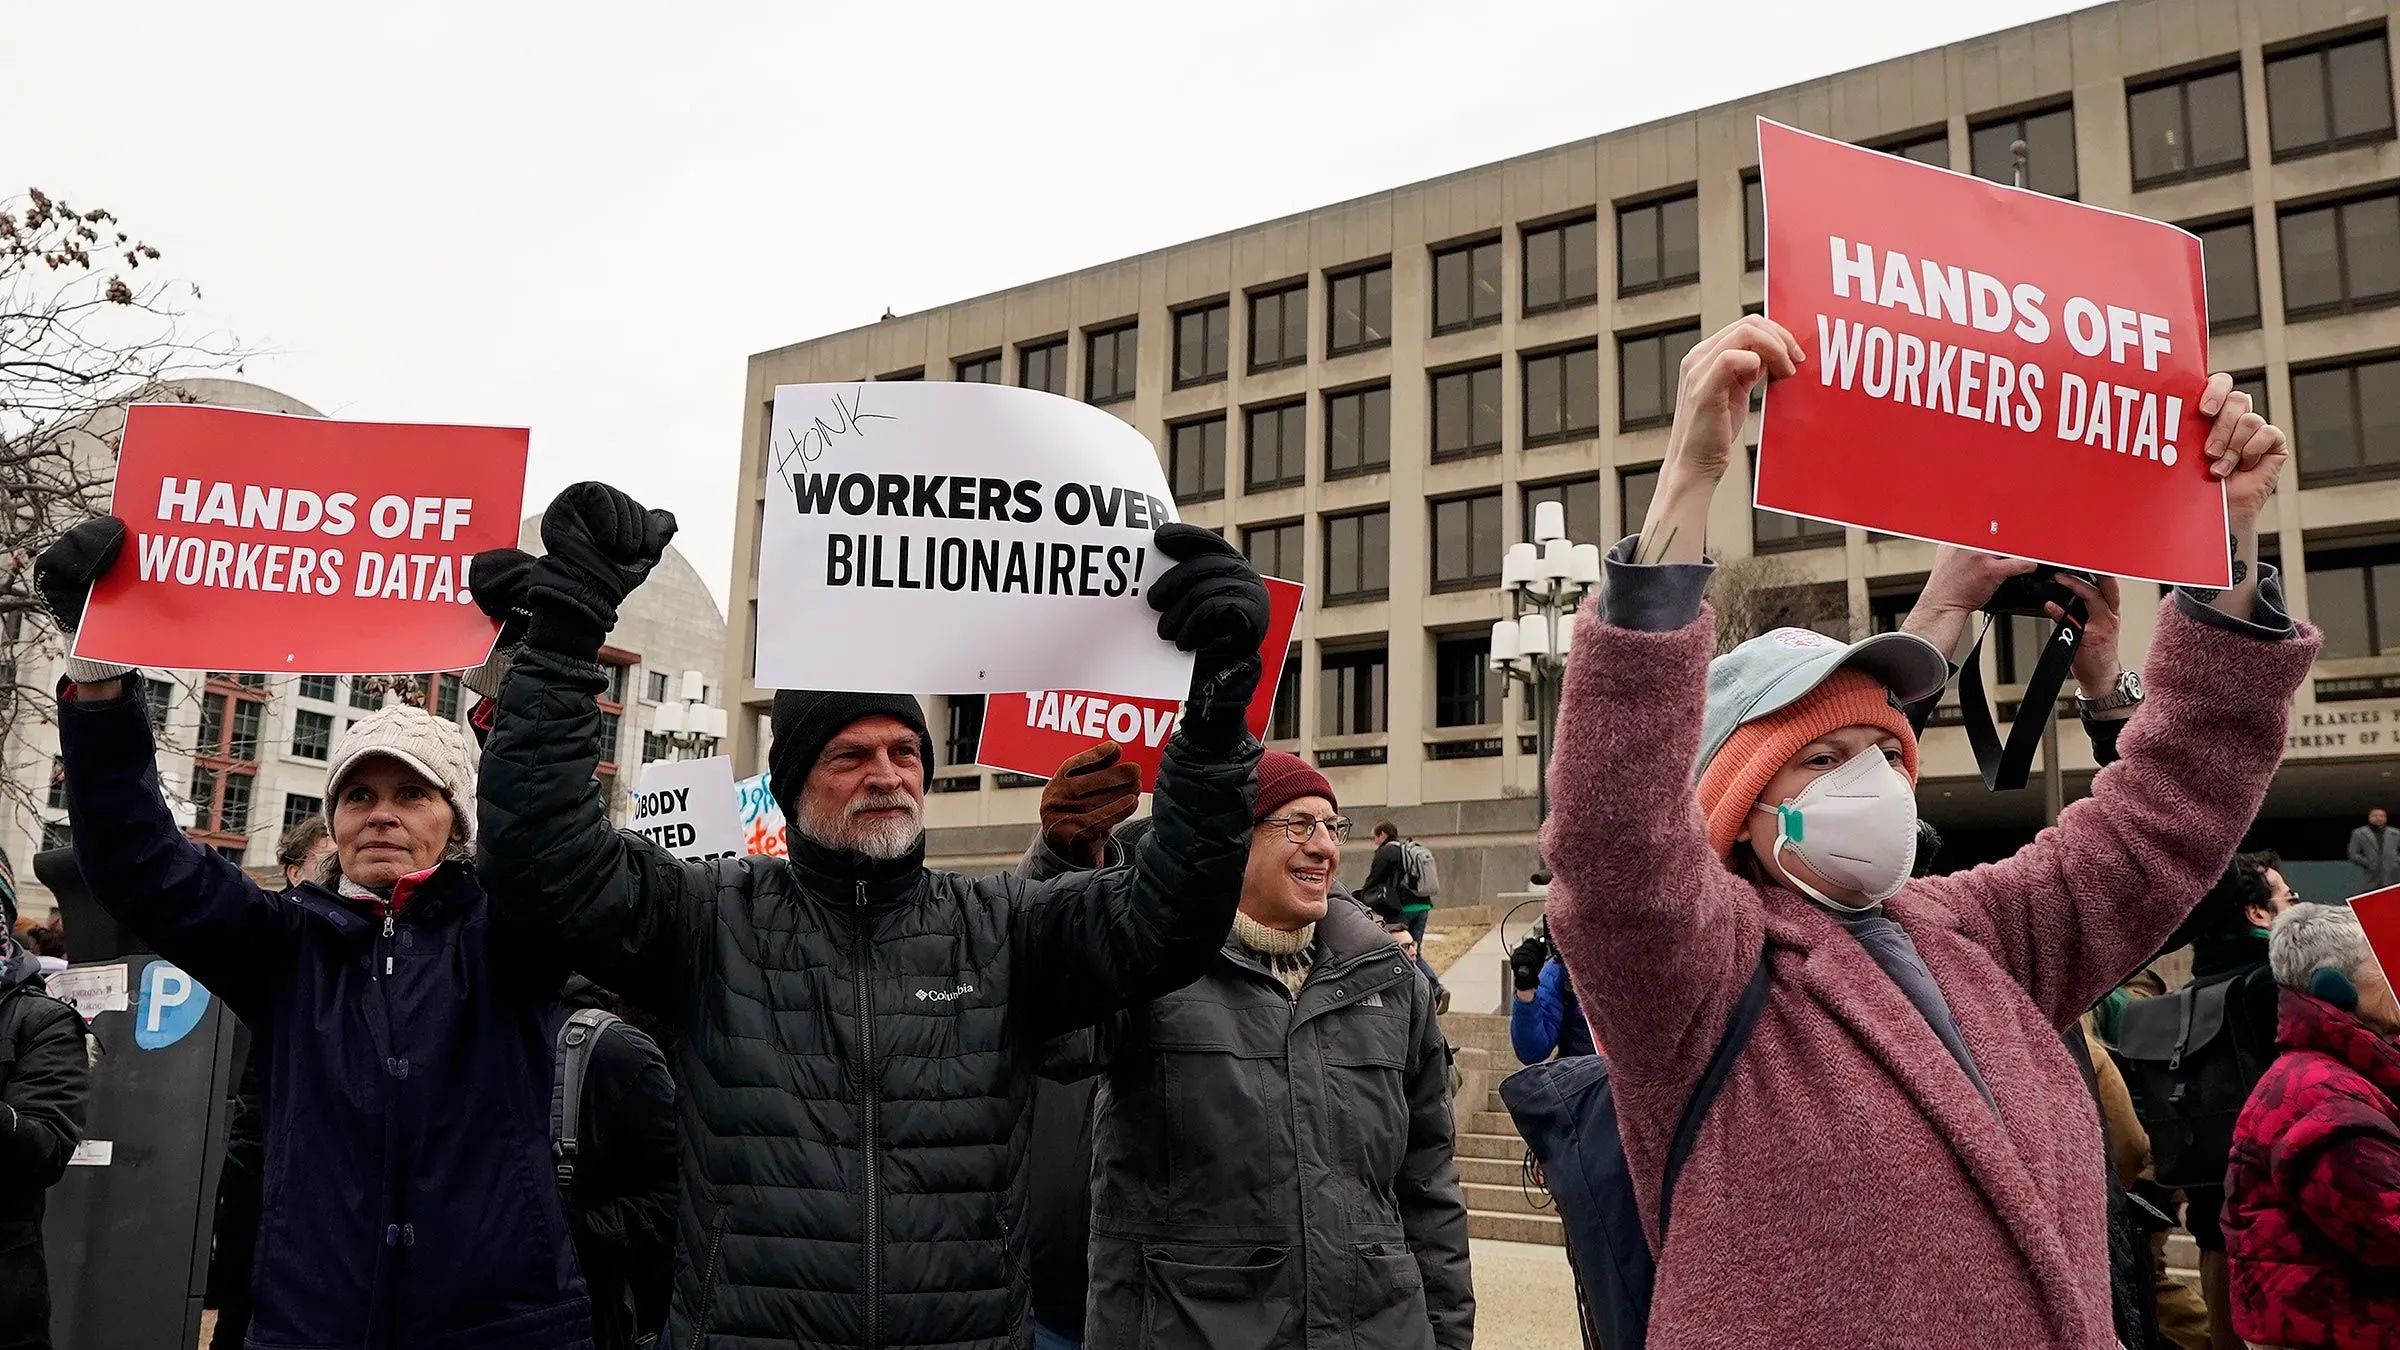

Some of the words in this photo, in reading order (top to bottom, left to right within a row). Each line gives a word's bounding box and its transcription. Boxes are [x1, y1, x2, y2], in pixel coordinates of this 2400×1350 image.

[1829, 235, 2051, 345] HANDS
[2063, 296, 2172, 372] OFF
[1816, 313, 2045, 433] WORKERS
[2056, 371, 2183, 467] DATA!
[775, 385, 898, 493] HONK
[157, 476, 359, 536] HANDS
[369, 494, 473, 541] OFF
[793, 473, 1043, 524] WORKERS
[1054, 482, 1170, 531] OVER
[138, 532, 344, 597] WORKERS
[354, 551, 474, 606] DATA!
[826, 533, 1146, 599] BILLIONAIRES!
[1025, 690, 1181, 748] TAKEOV
[2288, 732, 2347, 749] TMENT
[2359, 731, 2380, 744] OF
[2302, 710, 2380, 727] FRANCES
[632, 787, 690, 821] OBODY
[146, 966, 192, 1032] P
[928, 983, 974, 1001] Columbia
